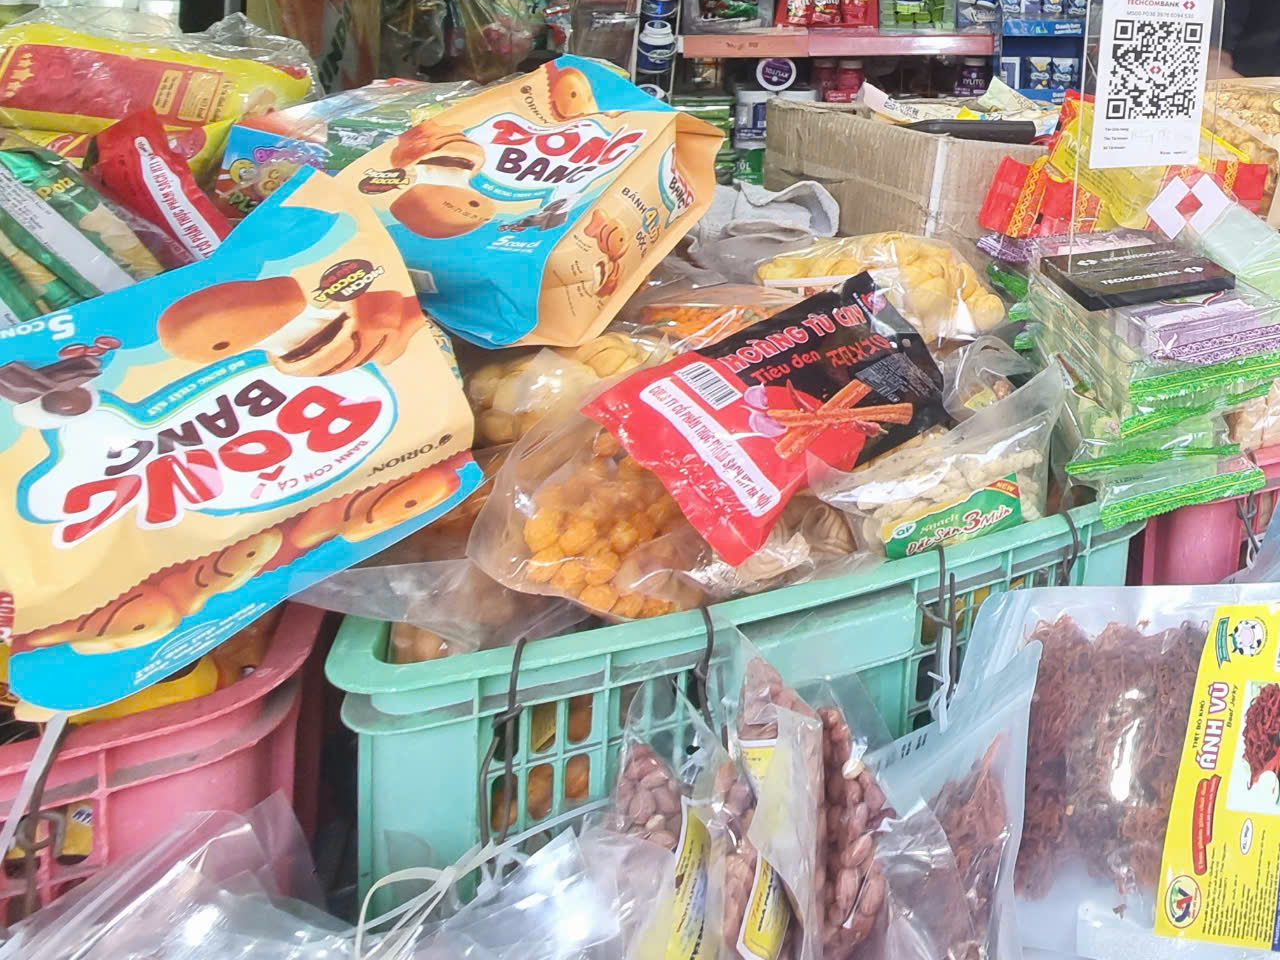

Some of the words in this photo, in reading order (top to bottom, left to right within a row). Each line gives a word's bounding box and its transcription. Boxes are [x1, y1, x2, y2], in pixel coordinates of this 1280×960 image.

[1101, 270, 1182, 286] TECHCOMBANK
[51, 314, 78, 341] 5
[718, 325, 810, 374] HOÀNG
[105, 379, 288, 476] BANG
[63, 385, 383, 543] BỐNG
[302, 461, 334, 481] CON
[370, 442, 435, 476] ORION
[996, 481, 1016, 493] NEW
[963, 510, 982, 534] 3
[1207, 680, 1231, 715] VŨ
[1194, 719, 1225, 771] ÁNH
